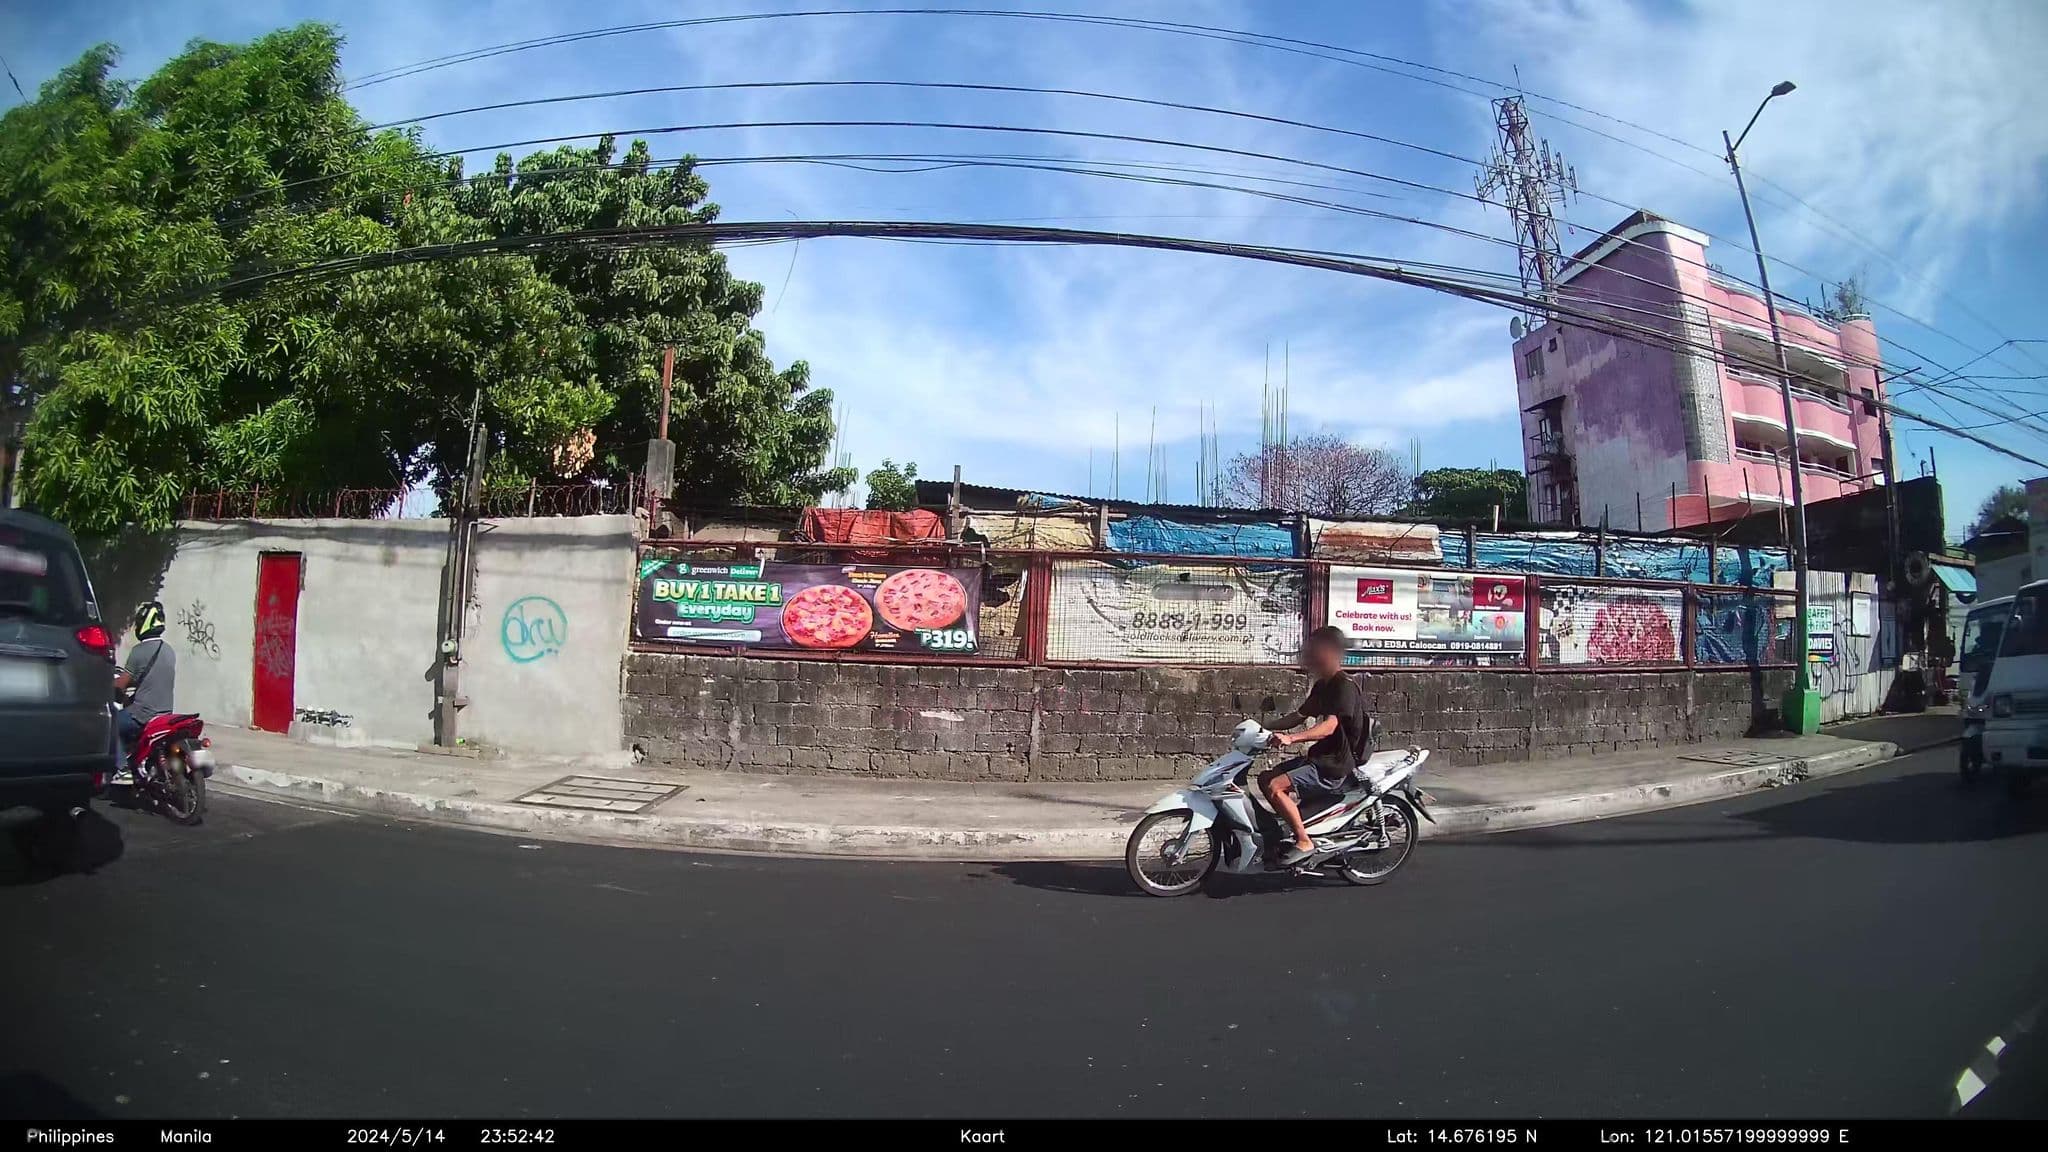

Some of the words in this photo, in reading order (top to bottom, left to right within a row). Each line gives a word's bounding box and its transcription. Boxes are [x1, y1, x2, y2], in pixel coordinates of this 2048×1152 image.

[691, 566, 728, 576] greenwich
[655, 580, 698, 599] BUY
[701, 583, 711, 600] 1
[714, 583, 767, 602] TAKE
[770, 585, 781, 602] 1
[680, 602, 754, 622] Everyday
[1335, 610, 1377, 621] Celebrate
[1379, 611, 1399, 621] with
[1400, 612, 1412, 621] us!
[1132, 611, 1248, 631] 8888-1-999
[1352, 622, 1374, 632] Book
[1375, 624, 1395, 632] now.
[1355, 640, 1382, 649] AX'S
[1384, 641, 1408, 649] EDSA
[1409, 641, 1447, 649] Caloocan
[1807, 637, 1833, 650] DAVIES
